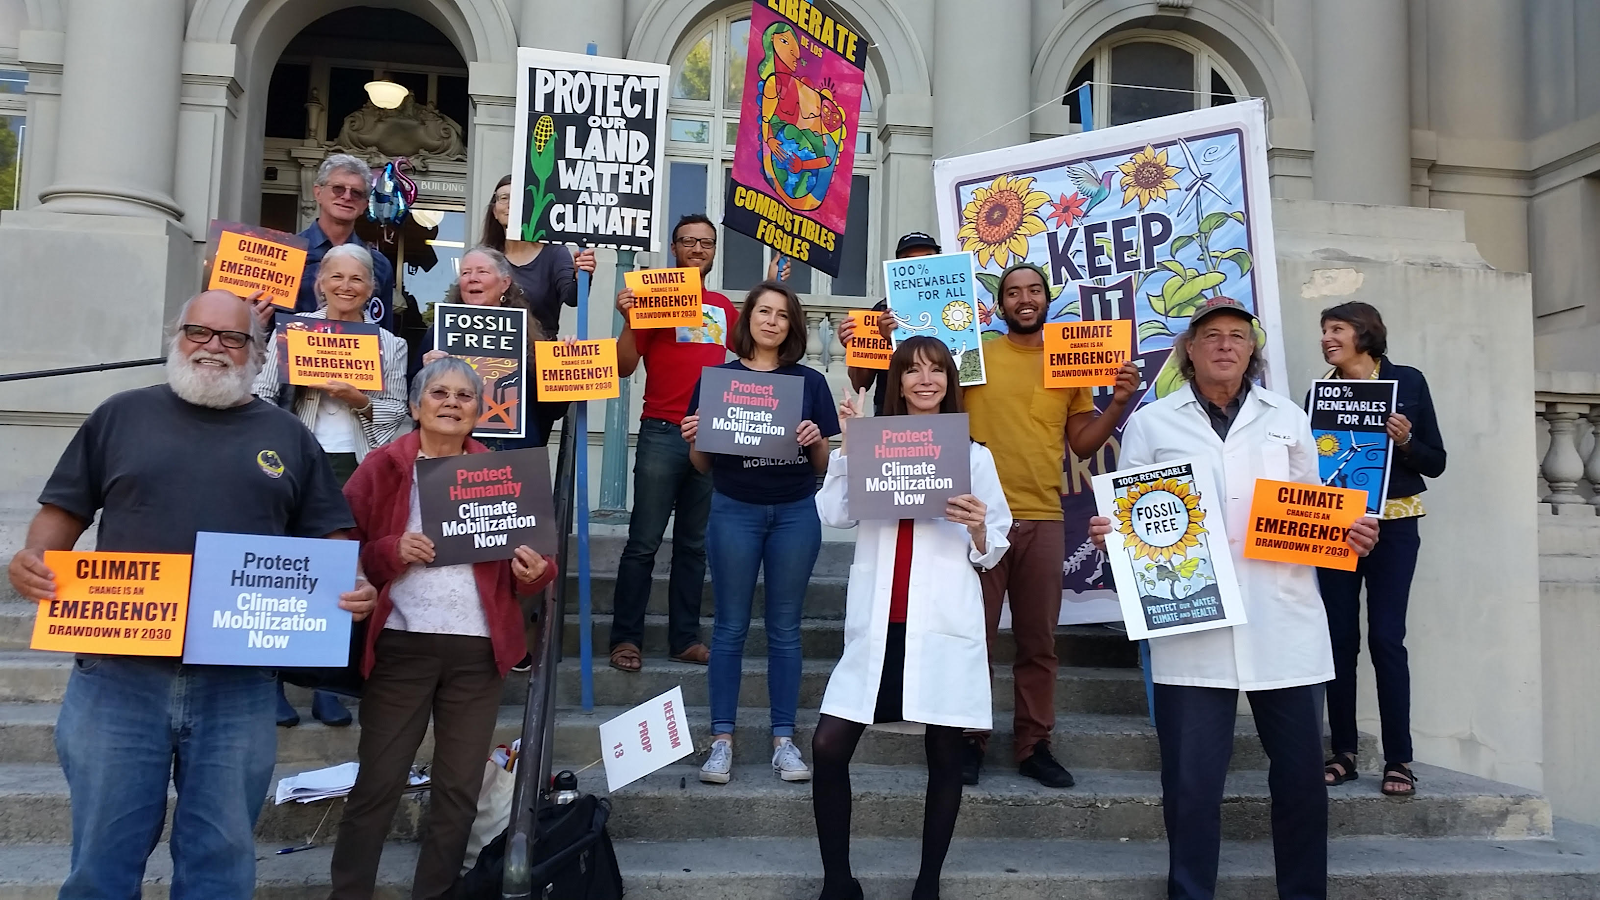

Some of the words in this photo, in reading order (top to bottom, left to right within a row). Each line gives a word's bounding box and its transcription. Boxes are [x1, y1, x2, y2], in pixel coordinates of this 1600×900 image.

[801, 36, 809, 49] DE
[810, 43, 824, 58] LOS
[534, 69, 660, 119] PROTECT
[587, 116, 626, 129] OUR
[565, 126, 650, 166] LAND,
[557, 160, 654, 195] WATER
[421, 181, 464, 192] BUILDING
[576, 192, 618, 206] AND
[550, 204, 650, 238] CLIMATE
[734, 186, 836, 252] COMBUSTIBLES
[238, 240, 288, 261] CLIMATE
[1046, 212, 1172, 285] KEEP
[244, 256, 263, 265] CHANGE
[220, 260, 295, 288] EMERGENCY!
[642, 272, 686, 284] CLIMATE
[892, 264, 929, 277] 100%
[219, 276, 260, 289] DRAWDOWN
[261, 284, 271, 292] BY
[272, 288, 289, 297] 2030
[894, 273, 966, 290] RENEWABLES
[634, 295, 698, 308] EMERGENCY!
[918, 290, 940, 301] FOR
[945, 287, 966, 298] ALL
[1092, 290, 1124, 320] IT
[445, 314, 517, 332] FOSSIL
[636, 311, 671, 319] DRAWDOWN
[1062, 325, 1113, 339] CLIMATE
[307, 335, 360, 349] CLIMATE
[447, 332, 514, 350] FREE
[553, 344, 600, 358] CLIMATE
[852, 351, 887, 360] DRAWDOWN
[1050, 351, 1125, 366] EMERGENCY!
[295, 356, 375, 371] EMERGENCY!
[298, 370, 343, 379] DRAWDOWN
[344, 372, 353, 380] BY
[542, 366, 613, 380] EMERGENCY!
[1052, 369, 1093, 378] DRAWDOWN
[1094, 368, 1104, 376] BY
[1105, 368, 1119, 376] 203
[545, 384, 584, 392] DRAWDOWN
[731, 380, 773, 396] Protect
[1318, 386, 1353, 398] 100%
[723, 391, 779, 410] Humanity
[1317, 400, 1386, 412] RENEWABLES
[727, 406, 772, 422] Climate
[1337, 414, 1359, 425] FOR
[1363, 415, 1384, 426] ALL
[712, 417, 785, 436] Mobilization
[734, 432, 761, 446] Now
[882, 429, 933, 444] Protect
[875, 443, 941, 459] Humanity
[456, 465, 512, 484] Protect
[881, 461, 936, 476] Climate
[1118, 476, 1140, 486] 100%
[1140, 465, 1188, 482] RENEWABLE
[449, 480, 522, 500] Humanity
[866, 475, 953, 491] Mobilization
[894, 491, 925, 505] Now
[1278, 487, 1344, 510] CLIMATE
[458, 500, 517, 519] Climate
[1136, 501, 1180, 521] FOSSIL
[1286, 509, 1312, 518] CHANGE
[442, 514, 536, 537] Mobilization
[1145, 518, 1178, 536] FREE
[474, 533, 508, 549] Now
[1255, 538, 1310, 552] DRAWDOWN
[1312, 545, 1324, 554] BY
[1325, 546, 1349, 557] 2030
[76, 559, 160, 581] CLIMATE
[243, 552, 310, 571] Protect
[88, 586, 121, 595] CHANGE
[123, 586, 132, 595] IS
[133, 587, 144, 595] AN
[231, 570, 318, 594] Humanity
[237, 592, 307, 612] Climate
[1147, 603, 1177, 615] PROTECT
[1192, 596, 1219, 608] WATER,
[48, 600, 178, 622] EMERGENCY!
[1152, 612, 1179, 624] CLIMATE
[1191, 606, 1217, 618] HEALTH
[212, 610, 327, 632] Mobilization
[48, 624, 121, 638] DRAWDOWN
[124, 628, 140, 638] BY
[141, 628, 171, 640] 2030
[248, 630, 289, 649] Now
[663, 700, 681, 749] REFORM
[638, 720, 652, 753] PROP
[613, 742, 624, 759] 13
